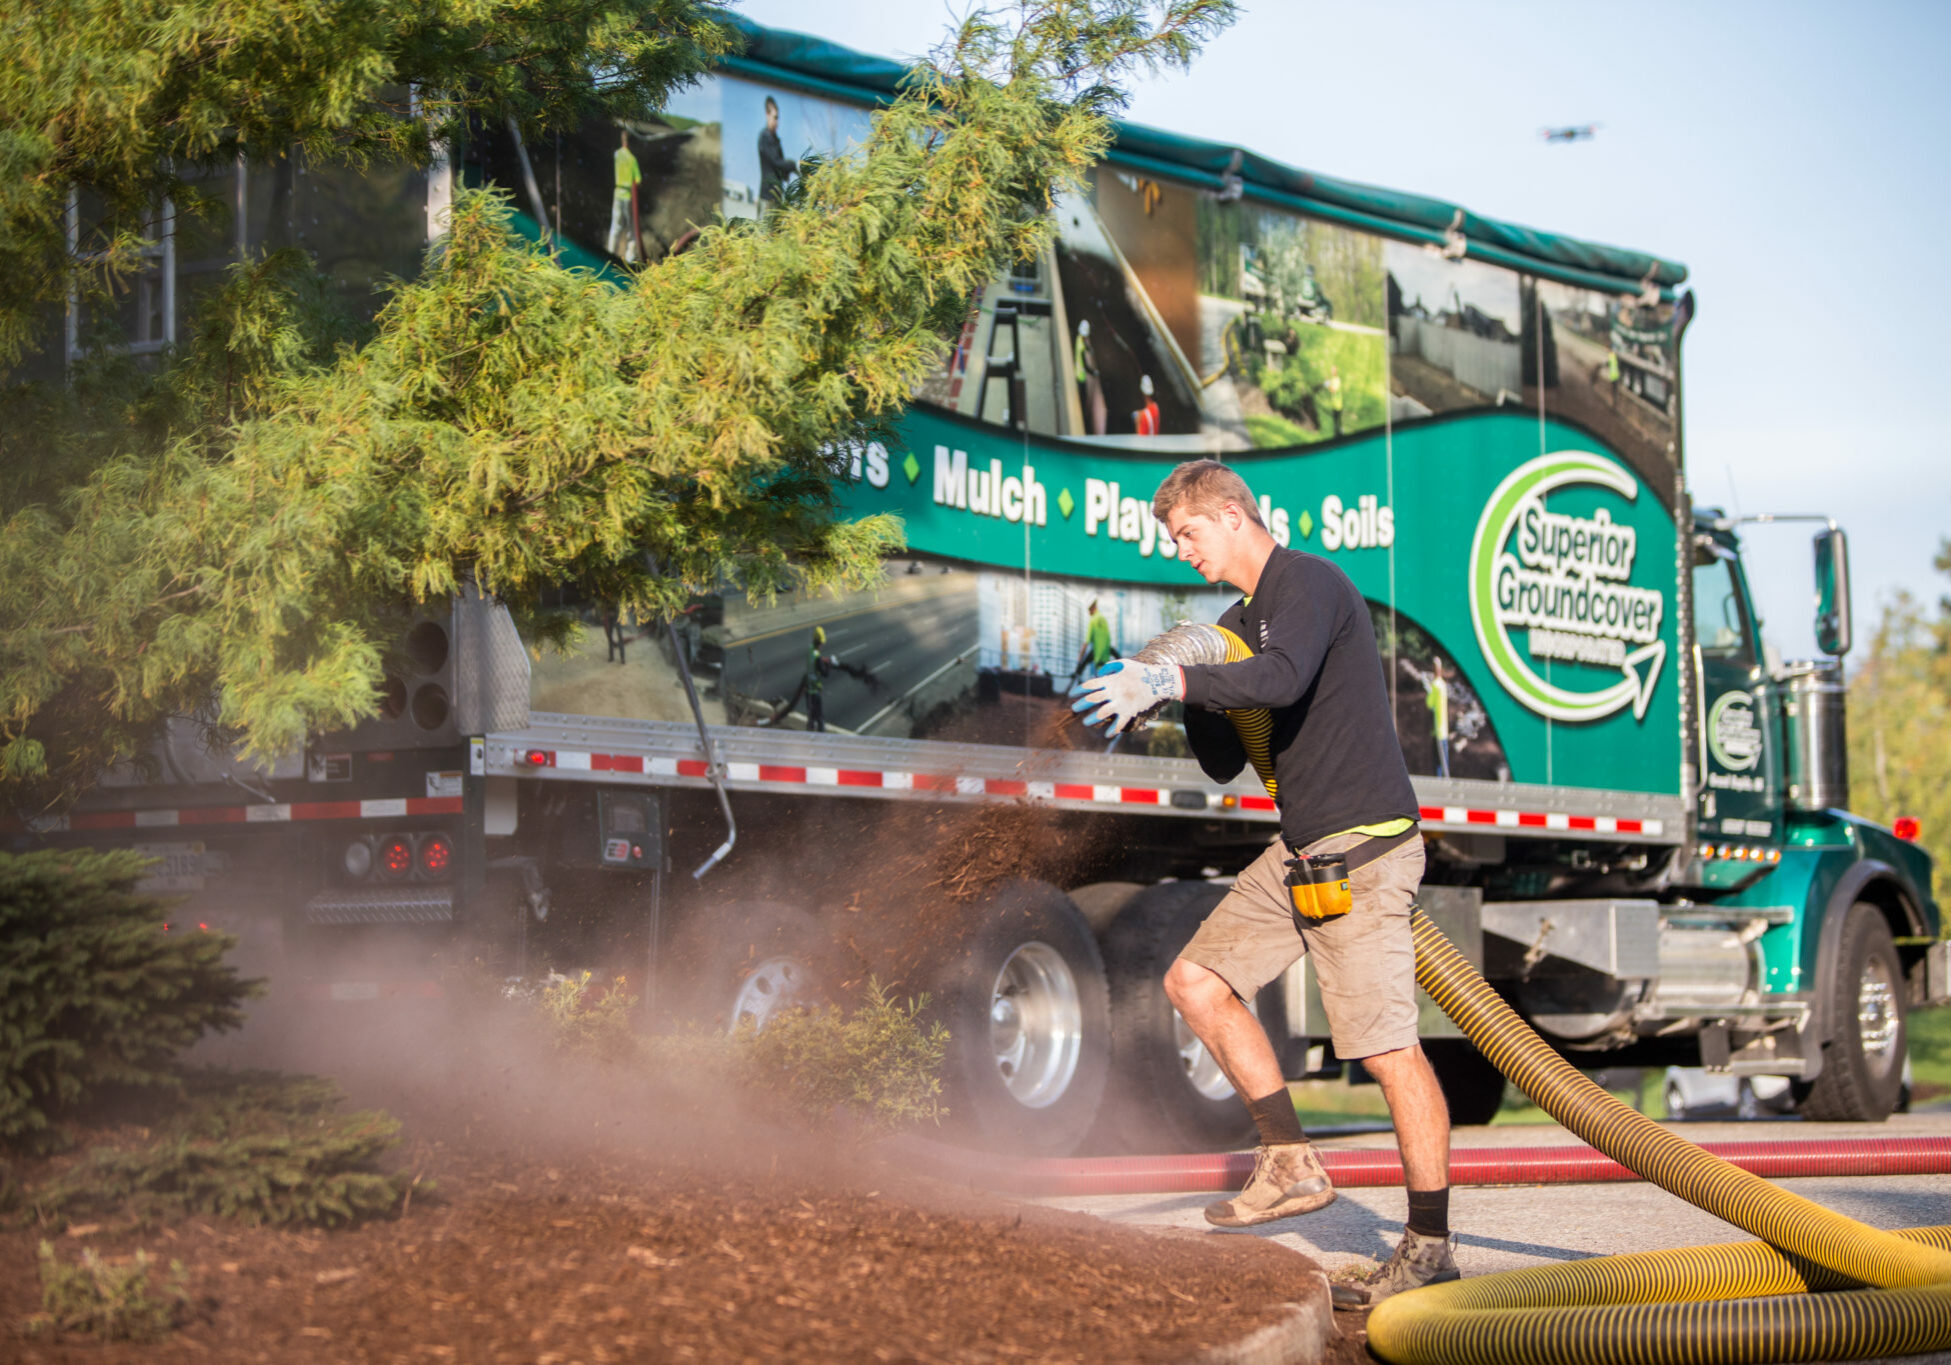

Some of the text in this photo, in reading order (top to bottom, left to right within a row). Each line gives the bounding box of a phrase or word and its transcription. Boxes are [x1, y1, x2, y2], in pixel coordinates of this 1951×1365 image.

[933, 445, 1047, 525] Mulch
[1321, 494, 1395, 549] Soils
[1524, 508, 1630, 568] Superior
[1498, 565, 1656, 632] Groundcover
